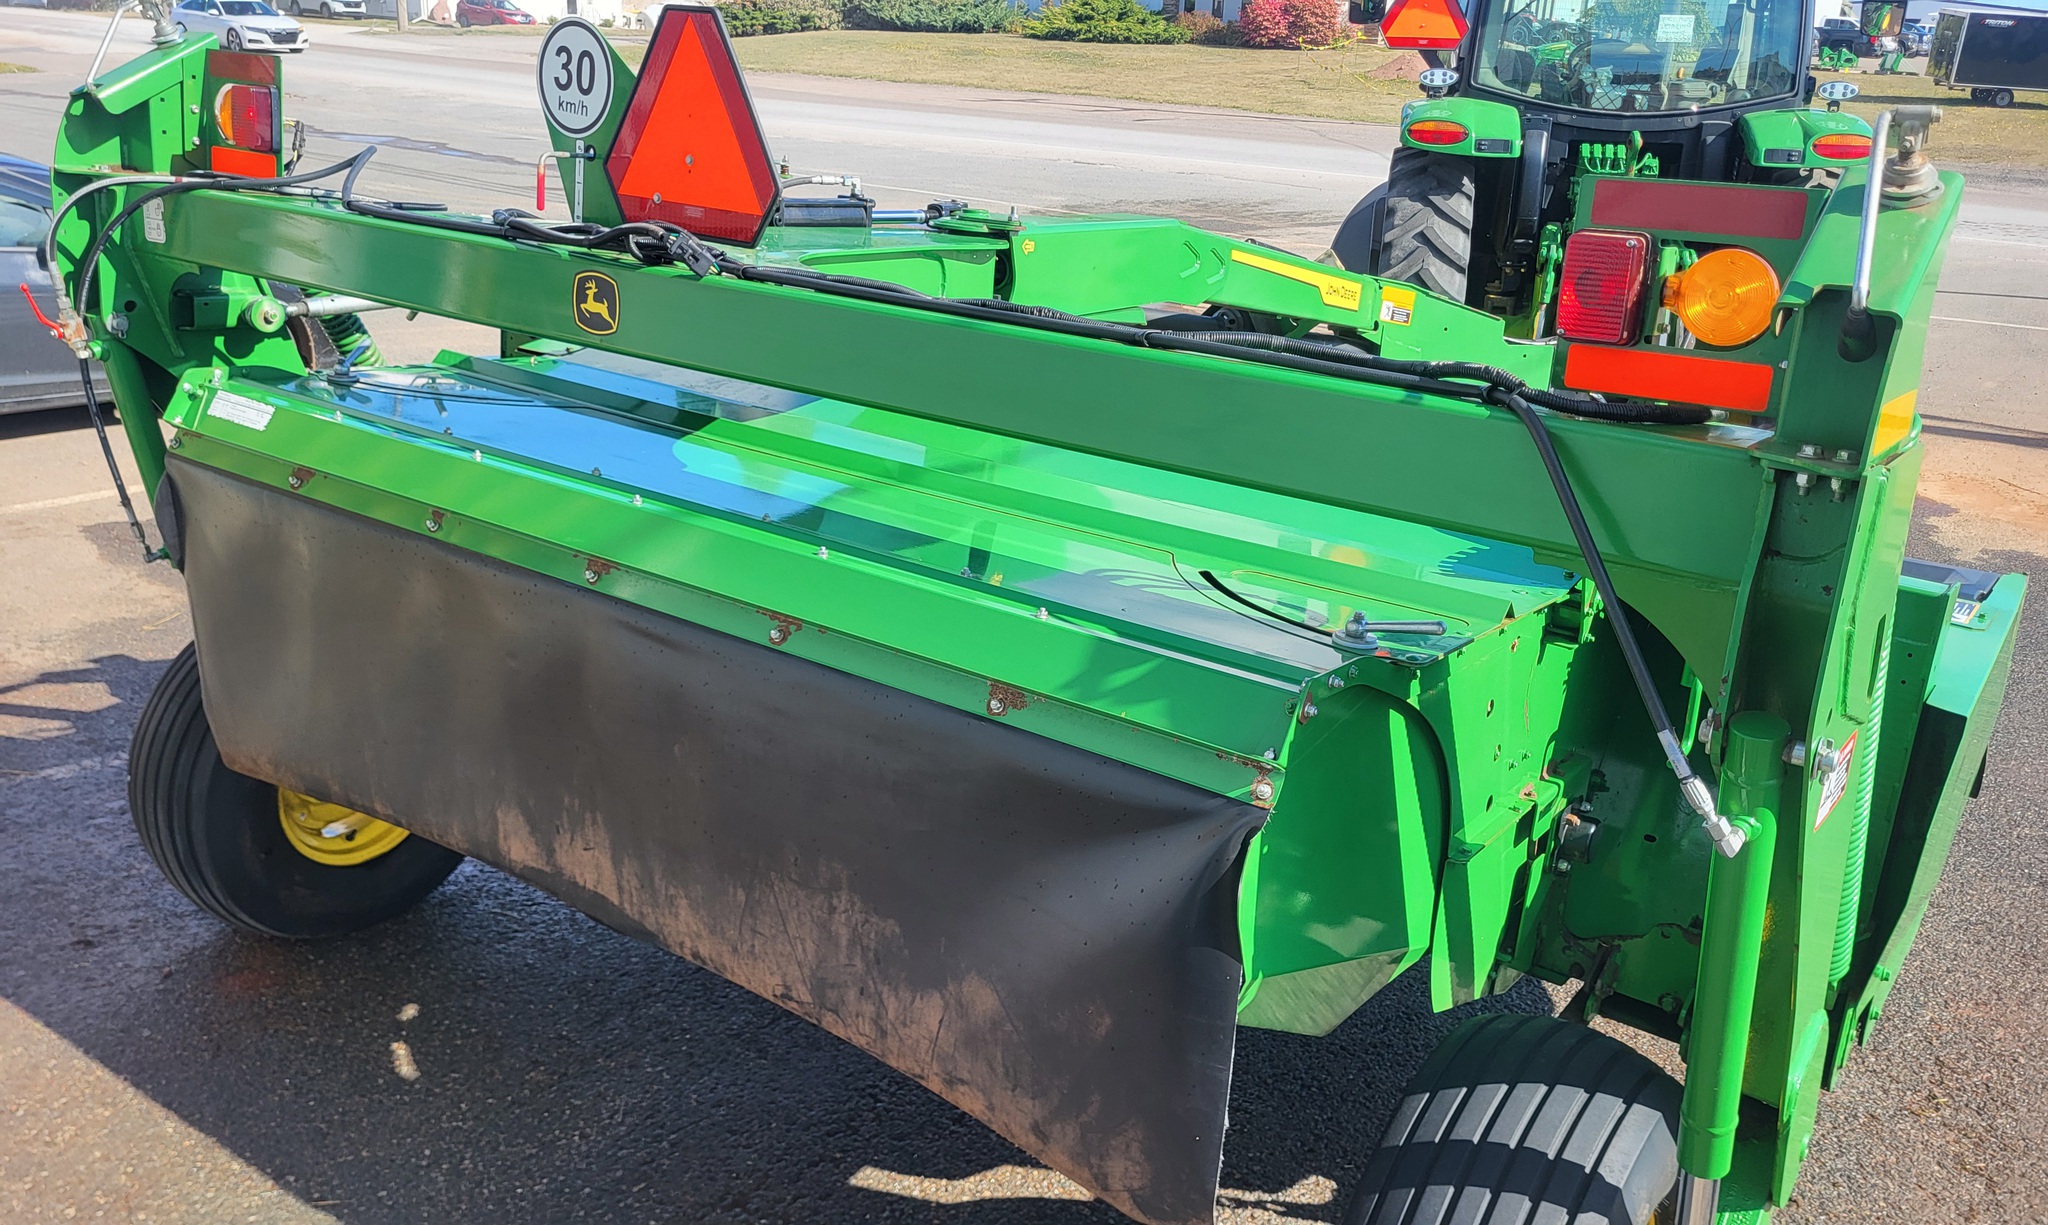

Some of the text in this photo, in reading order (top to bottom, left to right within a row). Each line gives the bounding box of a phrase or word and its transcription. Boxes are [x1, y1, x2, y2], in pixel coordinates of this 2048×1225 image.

[553, 45, 596, 96] 30
[558, 95, 588, 117] km/h
[1325, 282, 1358, 302] JOHN DEERE
